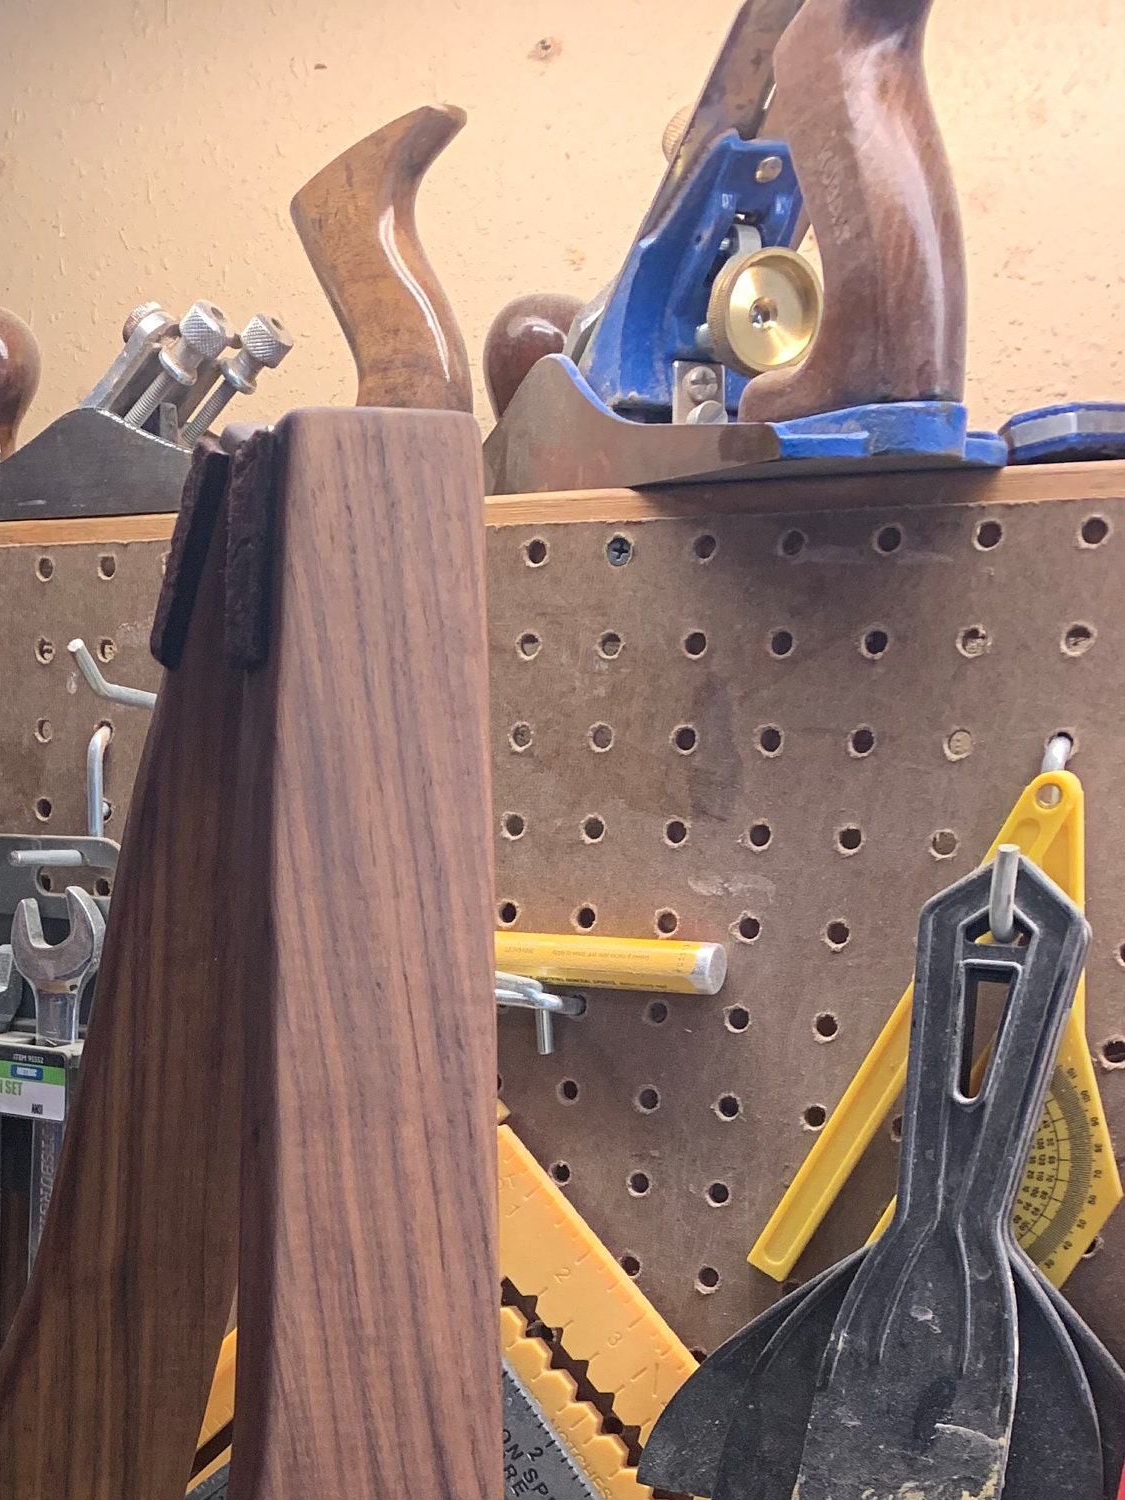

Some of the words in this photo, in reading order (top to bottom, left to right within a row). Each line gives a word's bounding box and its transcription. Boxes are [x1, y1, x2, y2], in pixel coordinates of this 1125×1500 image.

[5, 1080, 23, 1096] SET
[555, 1267, 572, 1284] 2
[607, 1331, 624, 1348] 3
[528, 1446, 544, 1462] 2
